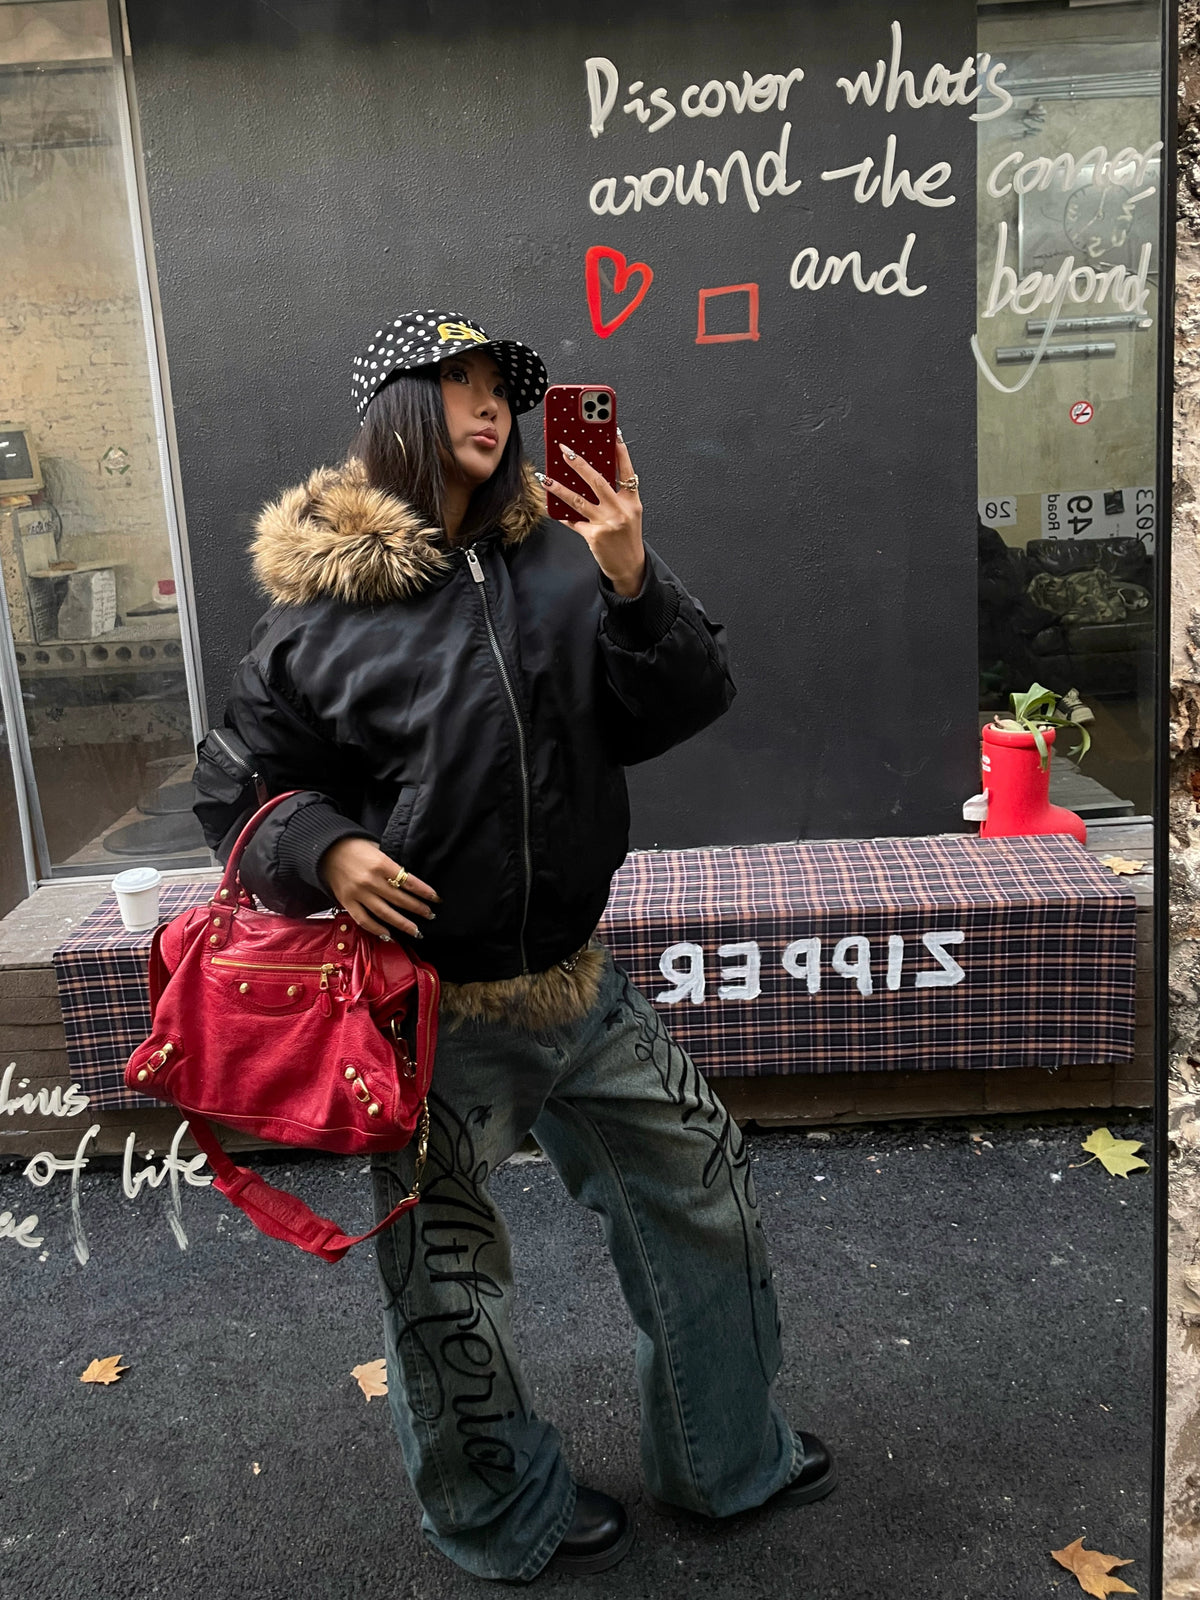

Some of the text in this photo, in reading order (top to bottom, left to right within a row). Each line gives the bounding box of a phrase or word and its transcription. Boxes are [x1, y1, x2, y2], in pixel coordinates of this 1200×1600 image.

[585, 20, 1014, 138] Discover what's
[589, 121, 802, 216] around
[821, 134, 956, 208] the
[789, 233, 927, 297] and
[22, 1123, 101, 1266] of
